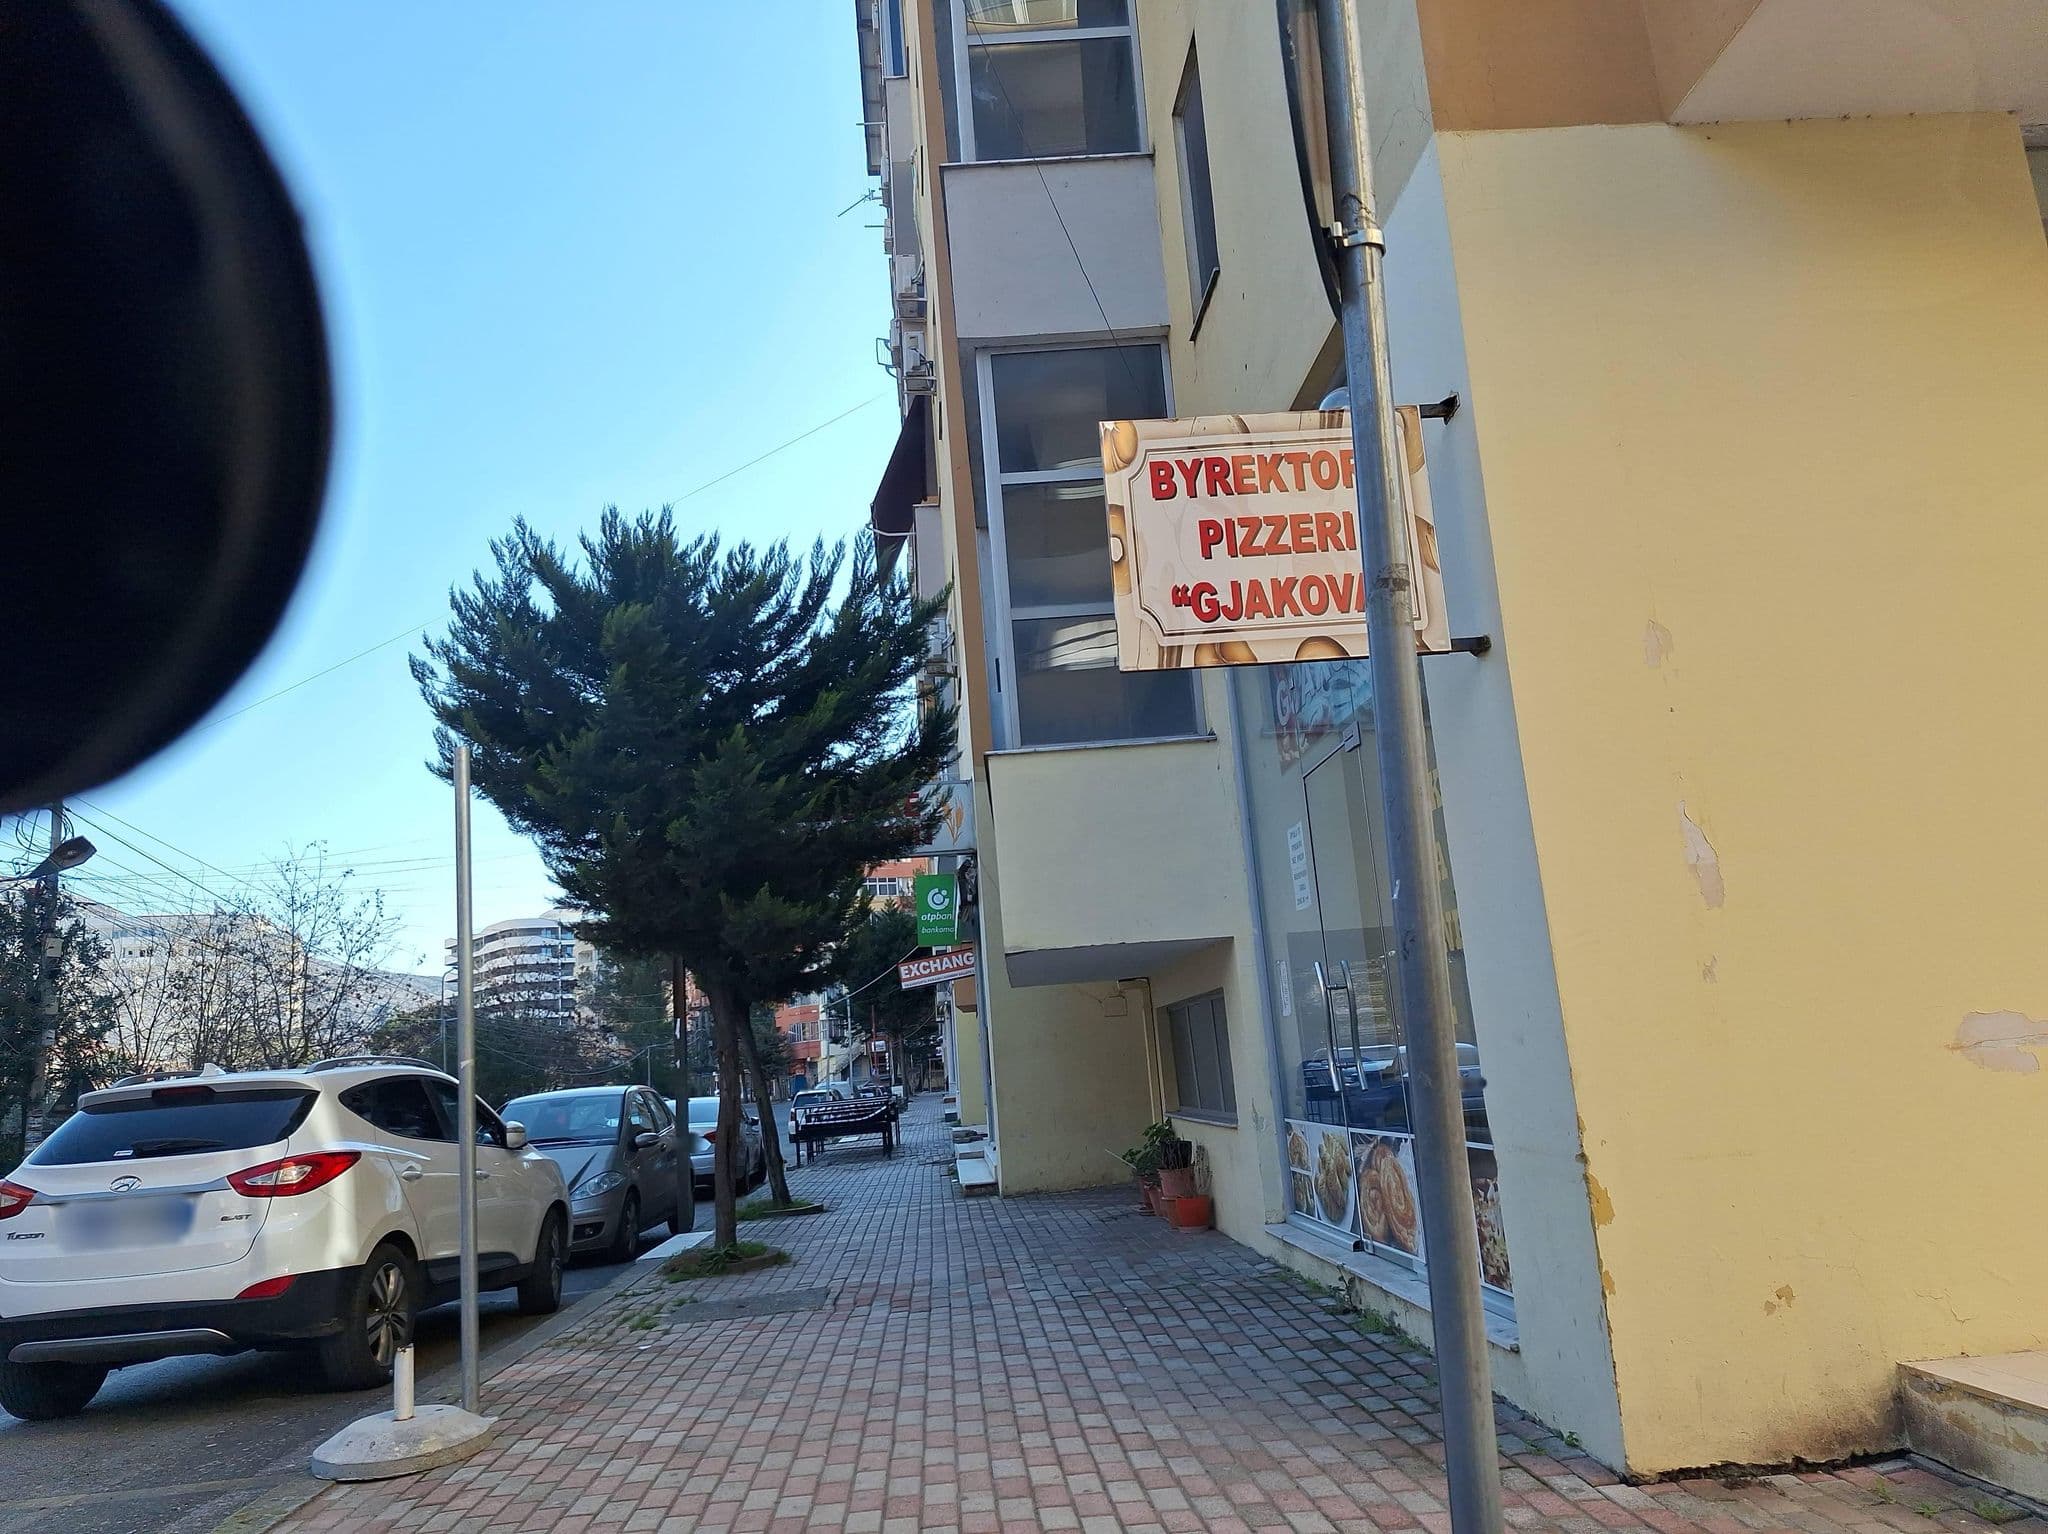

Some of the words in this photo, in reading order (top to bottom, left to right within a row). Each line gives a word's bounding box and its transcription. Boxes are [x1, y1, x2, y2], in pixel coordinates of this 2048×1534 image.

[1198, 511, 1357, 559] PIZZERI
[900, 952, 975, 979] EXCHANG
[7, 1231, 45, 1241] Tucson
